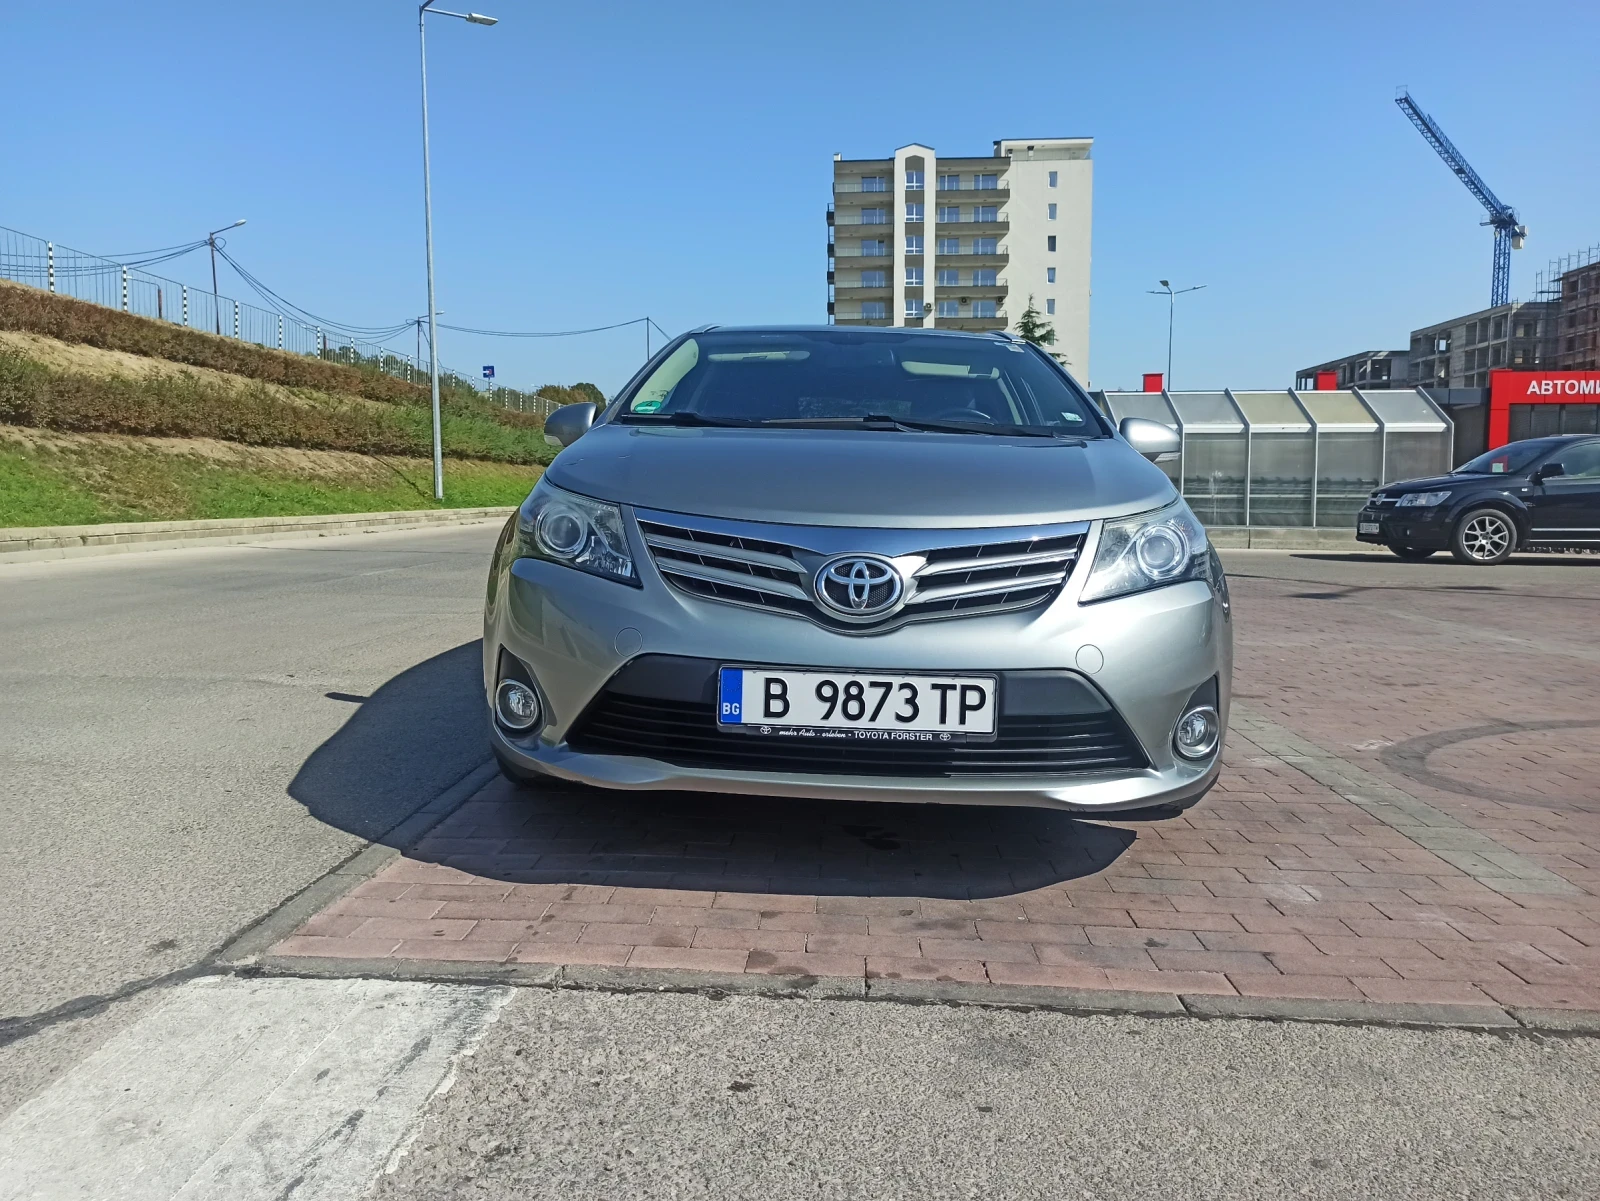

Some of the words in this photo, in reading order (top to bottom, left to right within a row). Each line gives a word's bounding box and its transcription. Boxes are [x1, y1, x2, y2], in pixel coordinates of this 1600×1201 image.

[763, 677, 790, 718] B
[815, 679, 920, 723] 9873
[931, 683, 986, 725] TP
[722, 702, 740, 715] BG
[853, 730, 889, 740] TOYOTA
